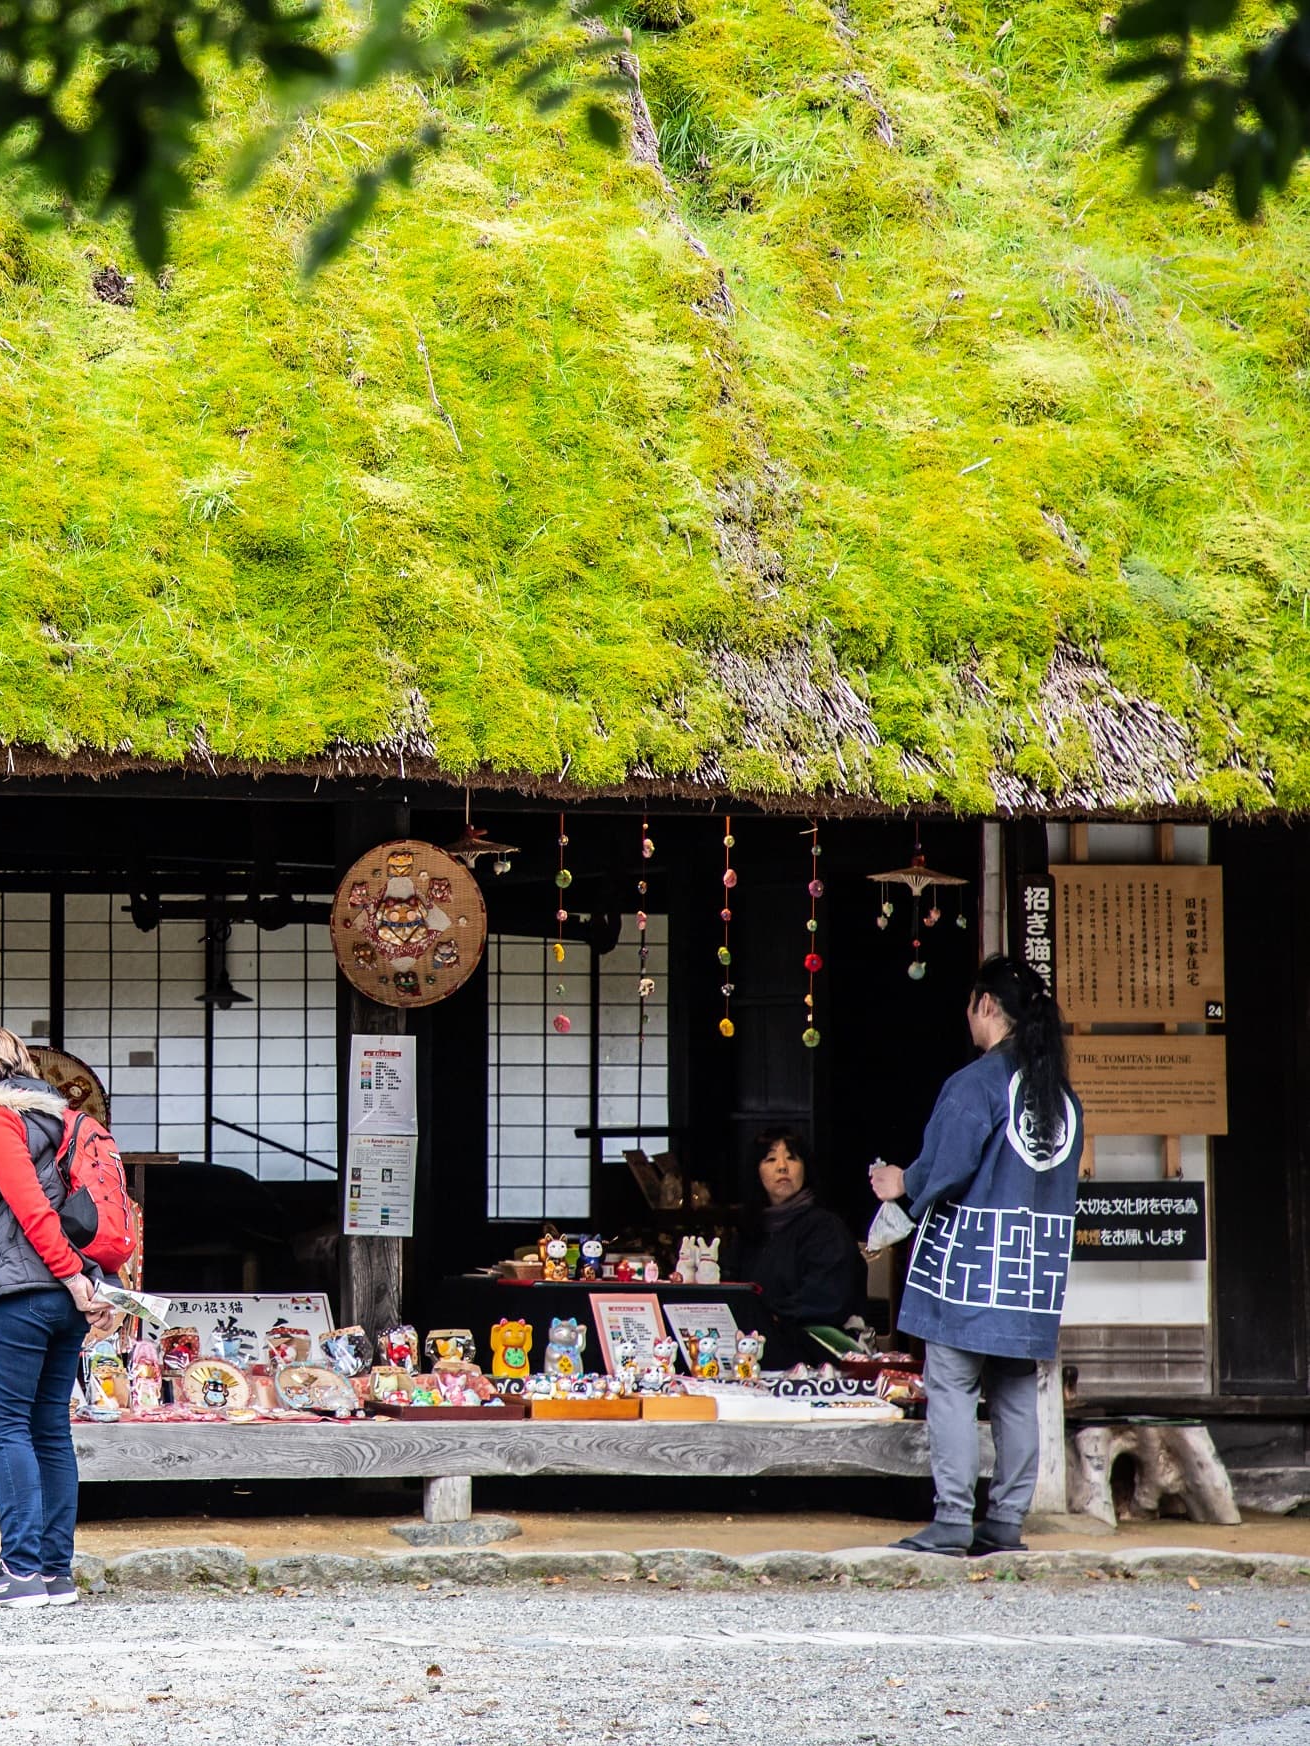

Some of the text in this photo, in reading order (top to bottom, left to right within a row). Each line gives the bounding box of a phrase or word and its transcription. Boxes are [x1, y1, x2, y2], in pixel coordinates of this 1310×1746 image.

[1185, 897, 1200, 987] 旧富田家住宅
[1208, 1004, 1222, 1017] 24
[1075, 1053, 1192, 1064] THE TOMITA'S HOUSE
[1075, 1198, 1198, 1215] 大切な文化財を守る為
[1076, 1228, 1186, 1246] 禁煙をお願いします
